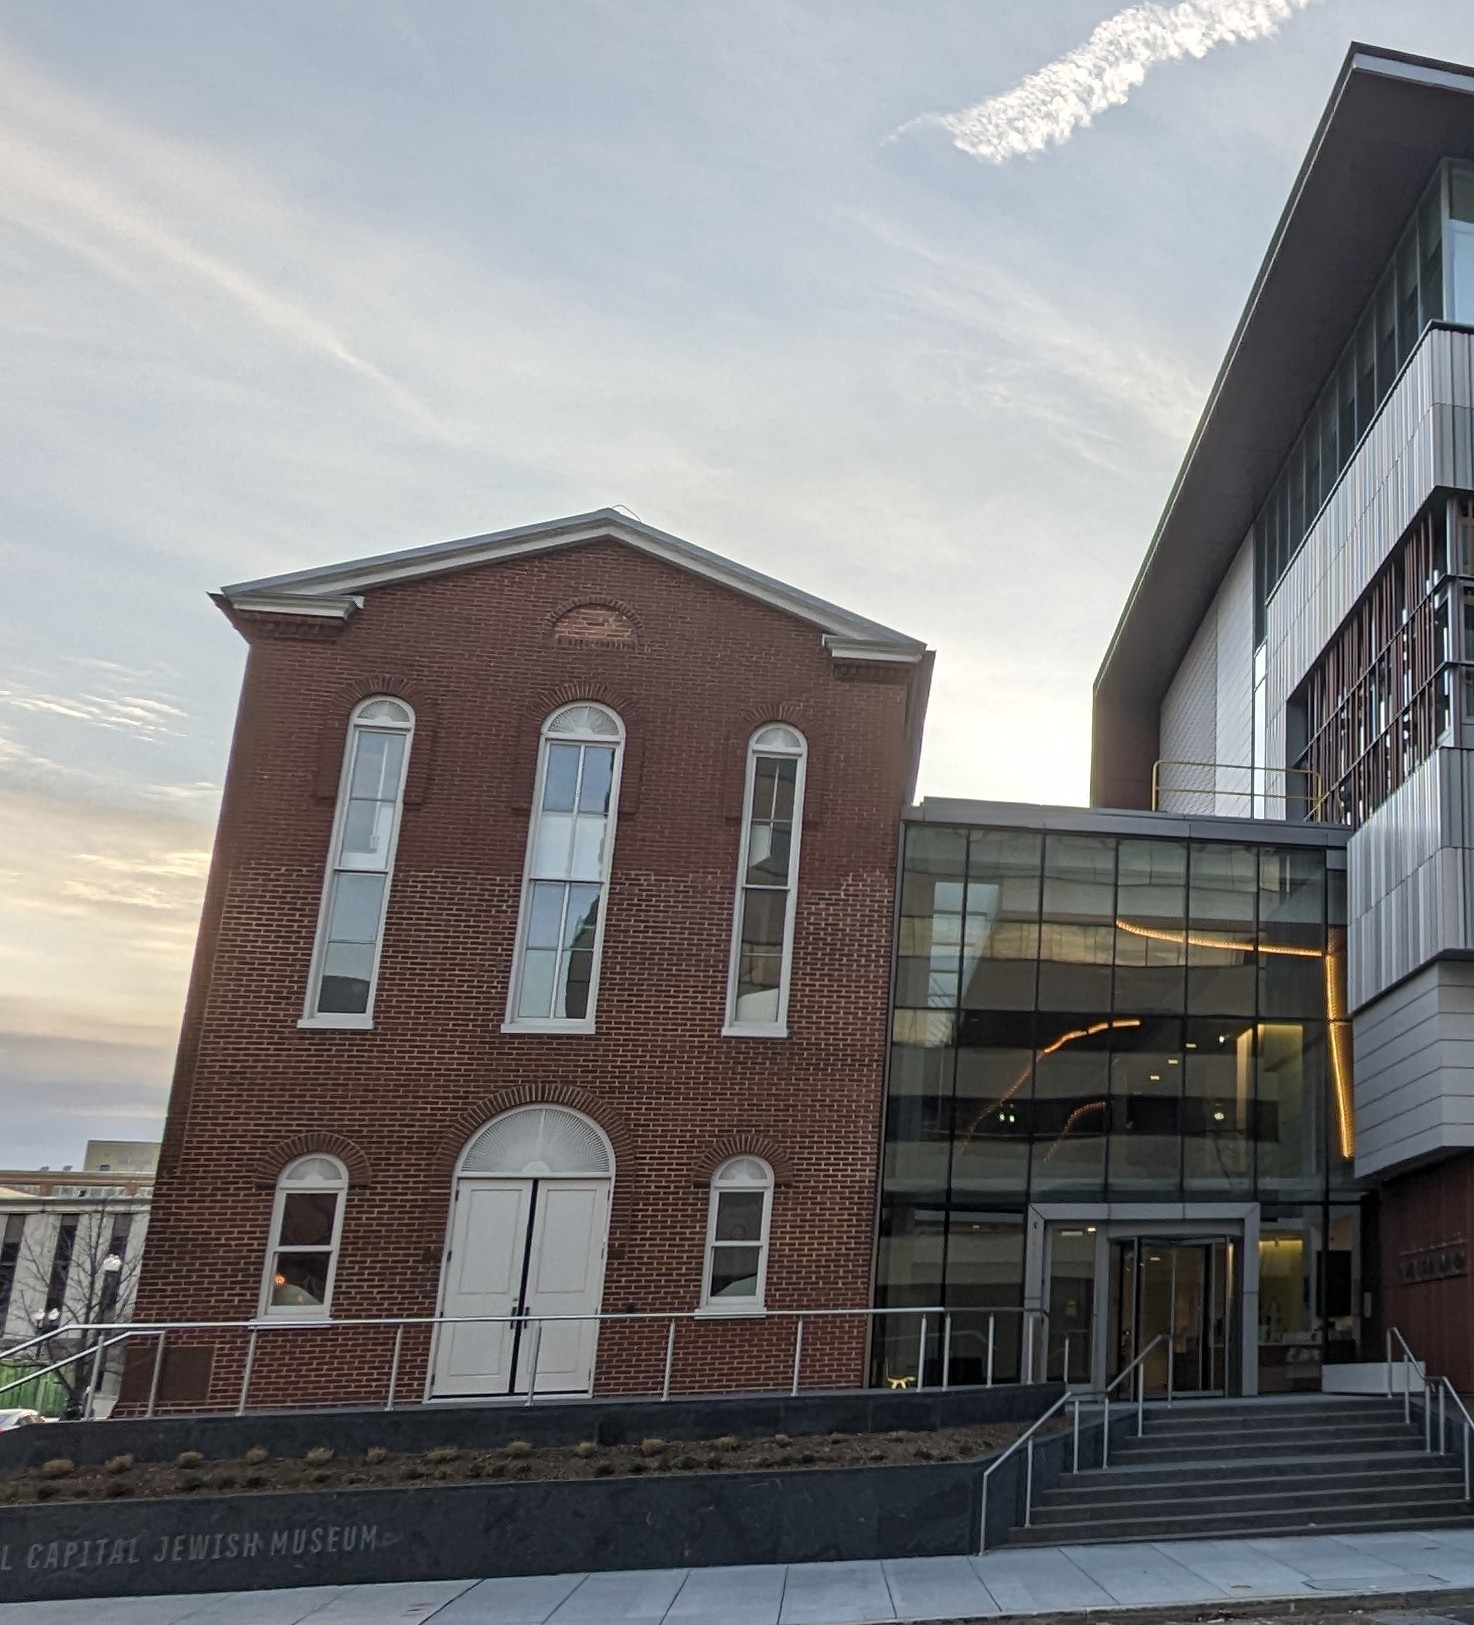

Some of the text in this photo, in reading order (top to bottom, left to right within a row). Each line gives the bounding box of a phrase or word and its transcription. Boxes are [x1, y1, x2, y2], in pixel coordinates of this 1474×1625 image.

[26, 1537, 140, 1571] CAPITAL
[153, 1531, 260, 1563] JEWISH
[270, 1525, 379, 1556] MUSEUM
